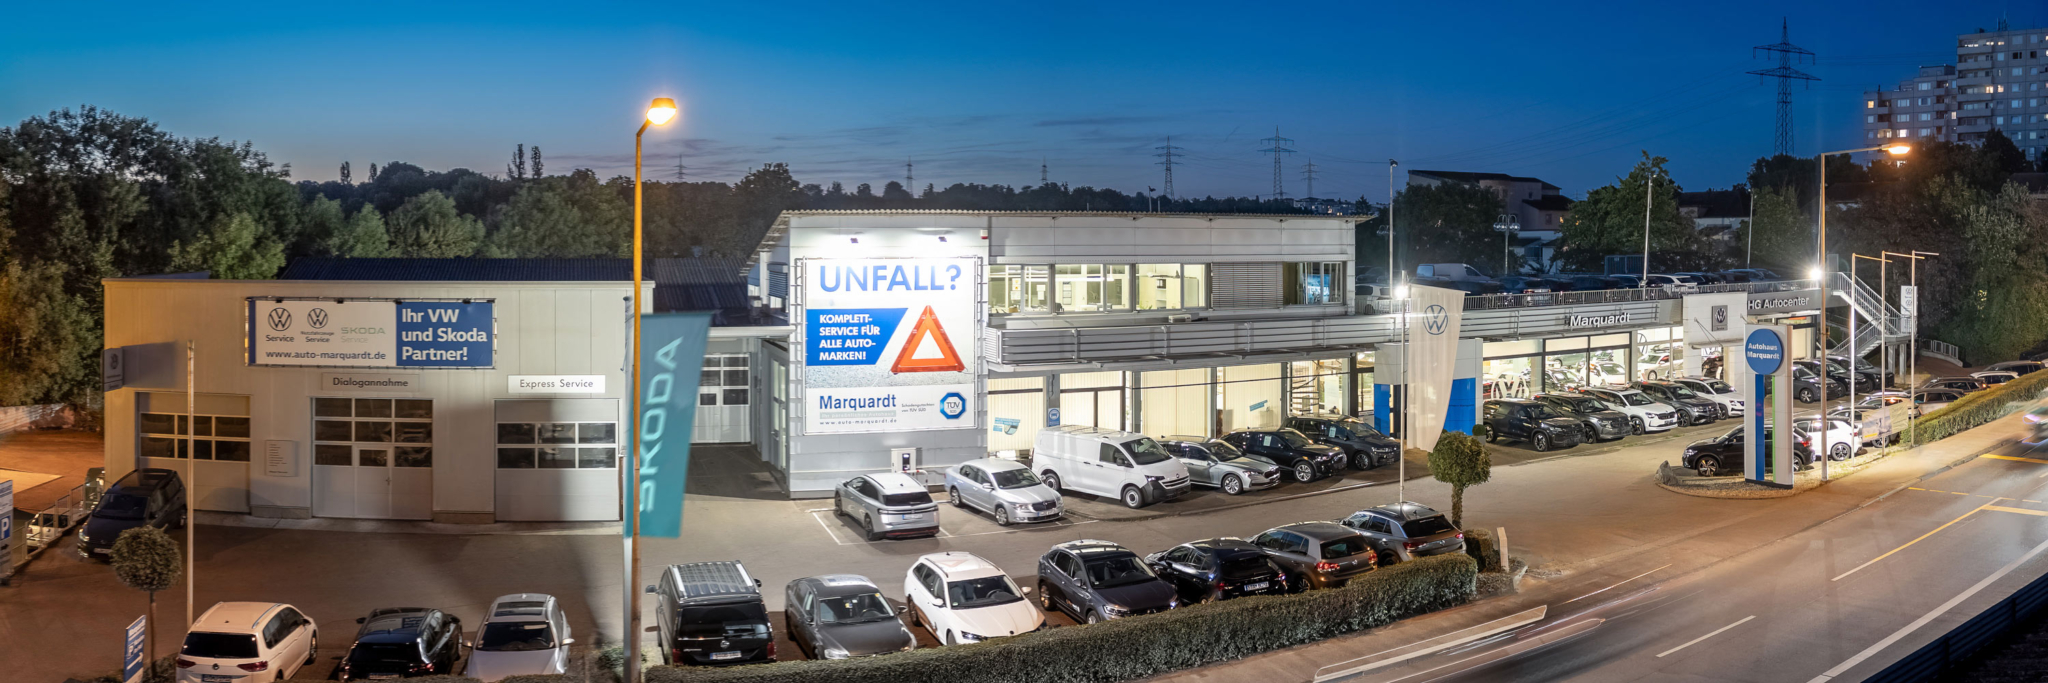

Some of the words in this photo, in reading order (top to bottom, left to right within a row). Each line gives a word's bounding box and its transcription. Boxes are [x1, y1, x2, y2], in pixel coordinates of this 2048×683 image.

[820, 264, 962, 293] UNFALL?
[1747, 299, 1762, 310] HG
[1763, 296, 1810, 309] Autocenter
[401, 308, 425, 323] Ihr
[427, 308, 460, 323] VW
[819, 314, 873, 324] KOMPLETT-
[1569, 312, 1631, 328] Marquardt
[401, 327, 433, 342] und
[436, 327, 488, 342] Skoda
[819, 326, 859, 336] SERVICE
[860, 324, 881, 336] FÜR
[265, 334, 295, 343] Service
[340, 335, 369, 343] Service
[819, 339, 843, 349] ALLE
[844, 338, 876, 348] AUTO-
[1748, 342, 1778, 351] Autohaus
[265, 350, 387, 360] www.auto-marquardt.de
[401, 346, 468, 361] Partner!
[819, 351, 866, 361] MARKEN!
[1747, 351, 1780, 360] Marquardt
[332, 377, 409, 389] Dialogannahme
[519, 378, 555, 390] Express
[559, 378, 594, 389] Service
[819, 394, 897, 411] Marquardt
[819, 417, 897, 425] www.auto-marquardt.de
